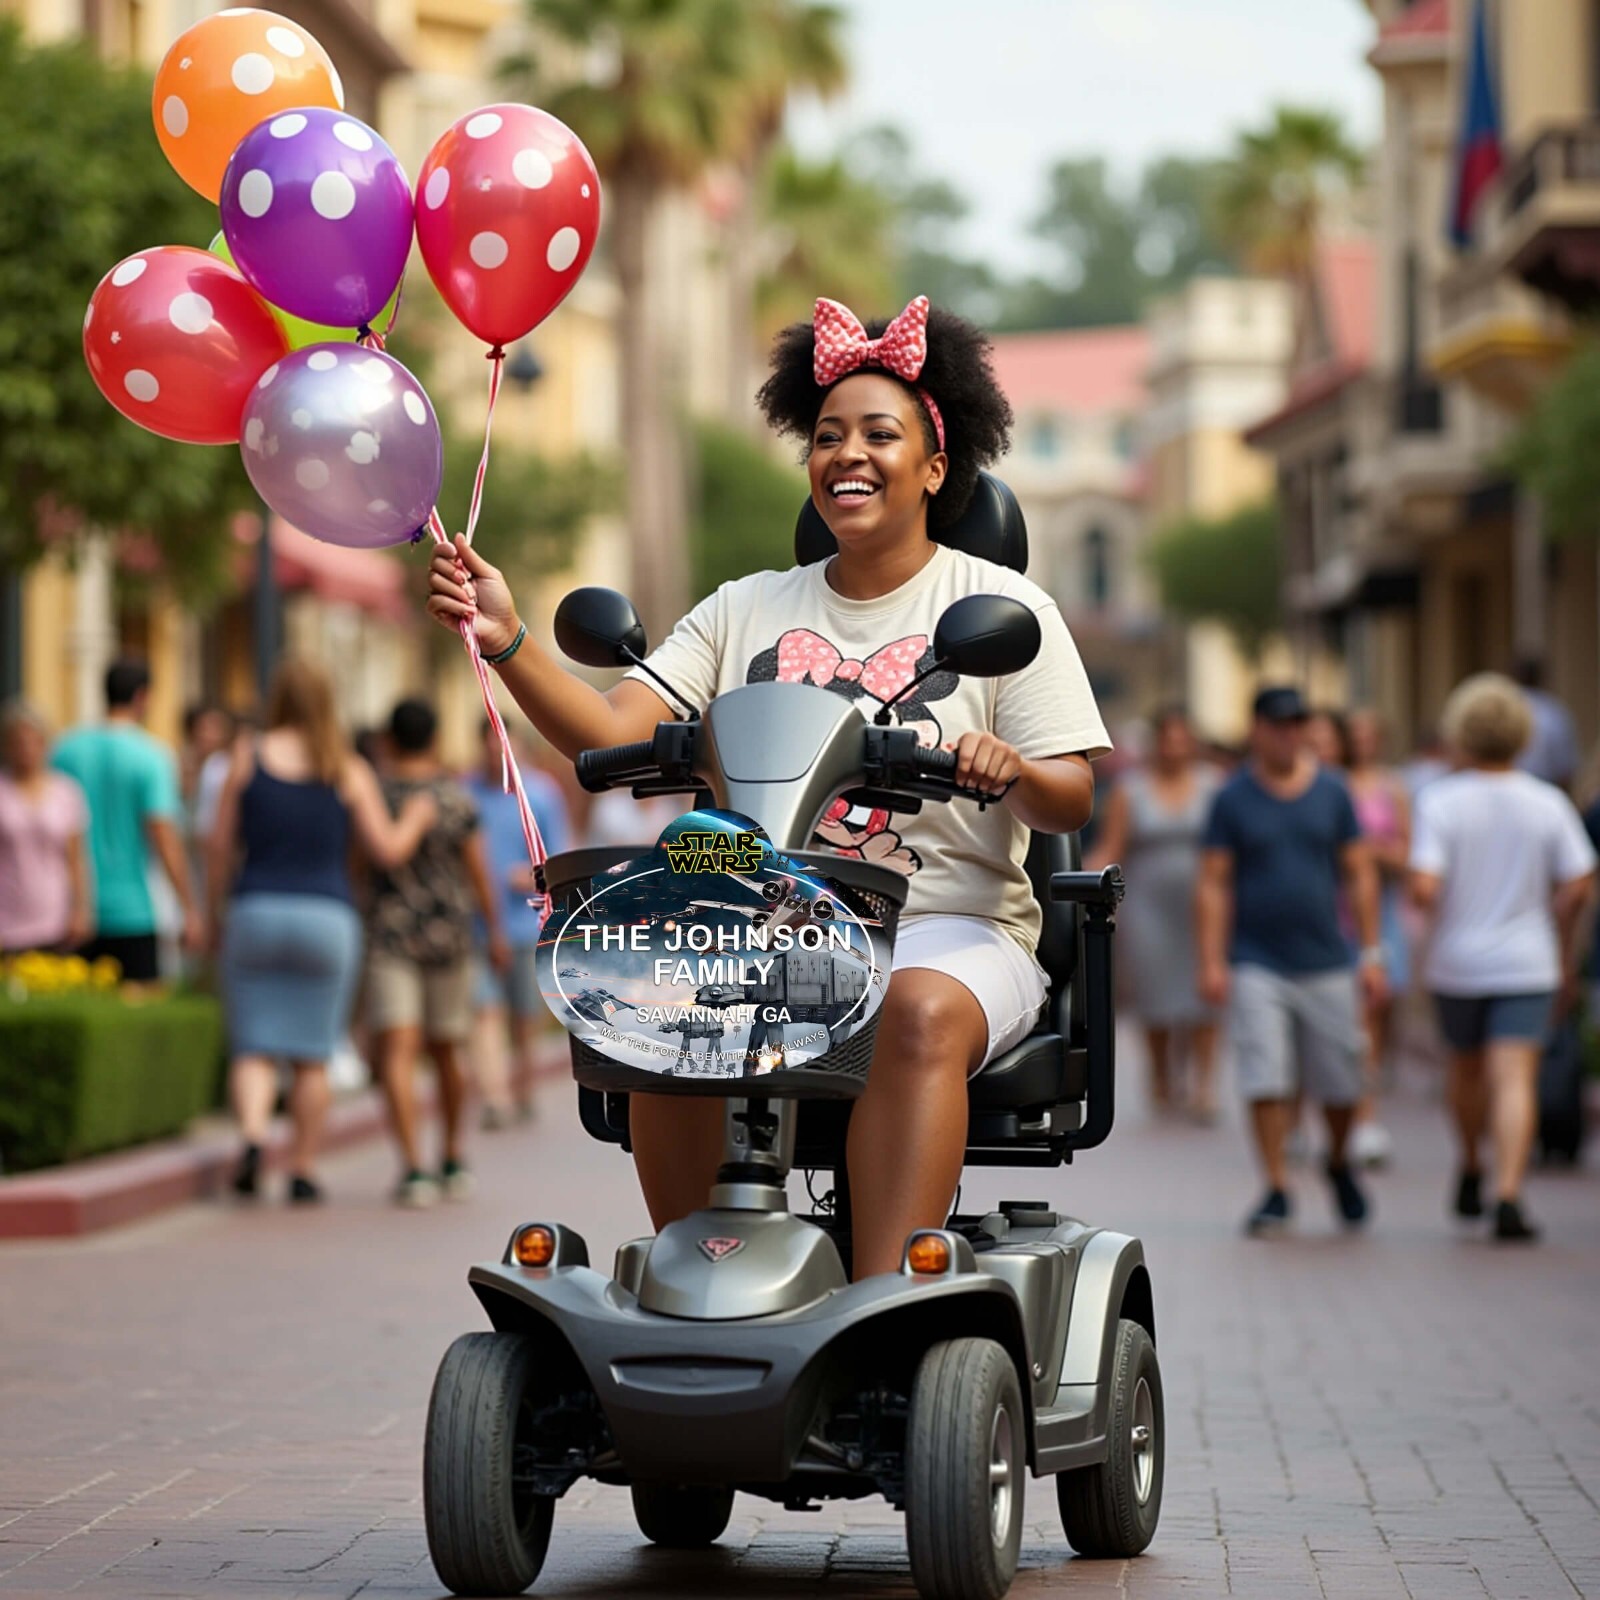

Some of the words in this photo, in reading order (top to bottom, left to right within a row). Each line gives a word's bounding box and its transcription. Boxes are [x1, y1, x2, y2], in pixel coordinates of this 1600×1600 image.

[667, 832, 763, 852] STAR
[668, 852, 763, 874] WARS
[576, 925, 651, 951] THE
[664, 924, 851, 951] JOHNSON
[653, 958, 775, 985] FAMILY
[636, 1006, 756, 1025] SAVANNAH,
[762, 1006, 792, 1023] GA
[601, 1027, 627, 1043] MAY
[628, 1037, 652, 1052] THE
[653, 1045, 693, 1060] FORCE
[696, 1052, 713, 1061] BE
[715, 1051, 746, 1061] WITH
[780, 1030, 826, 1053] ALWAYS
